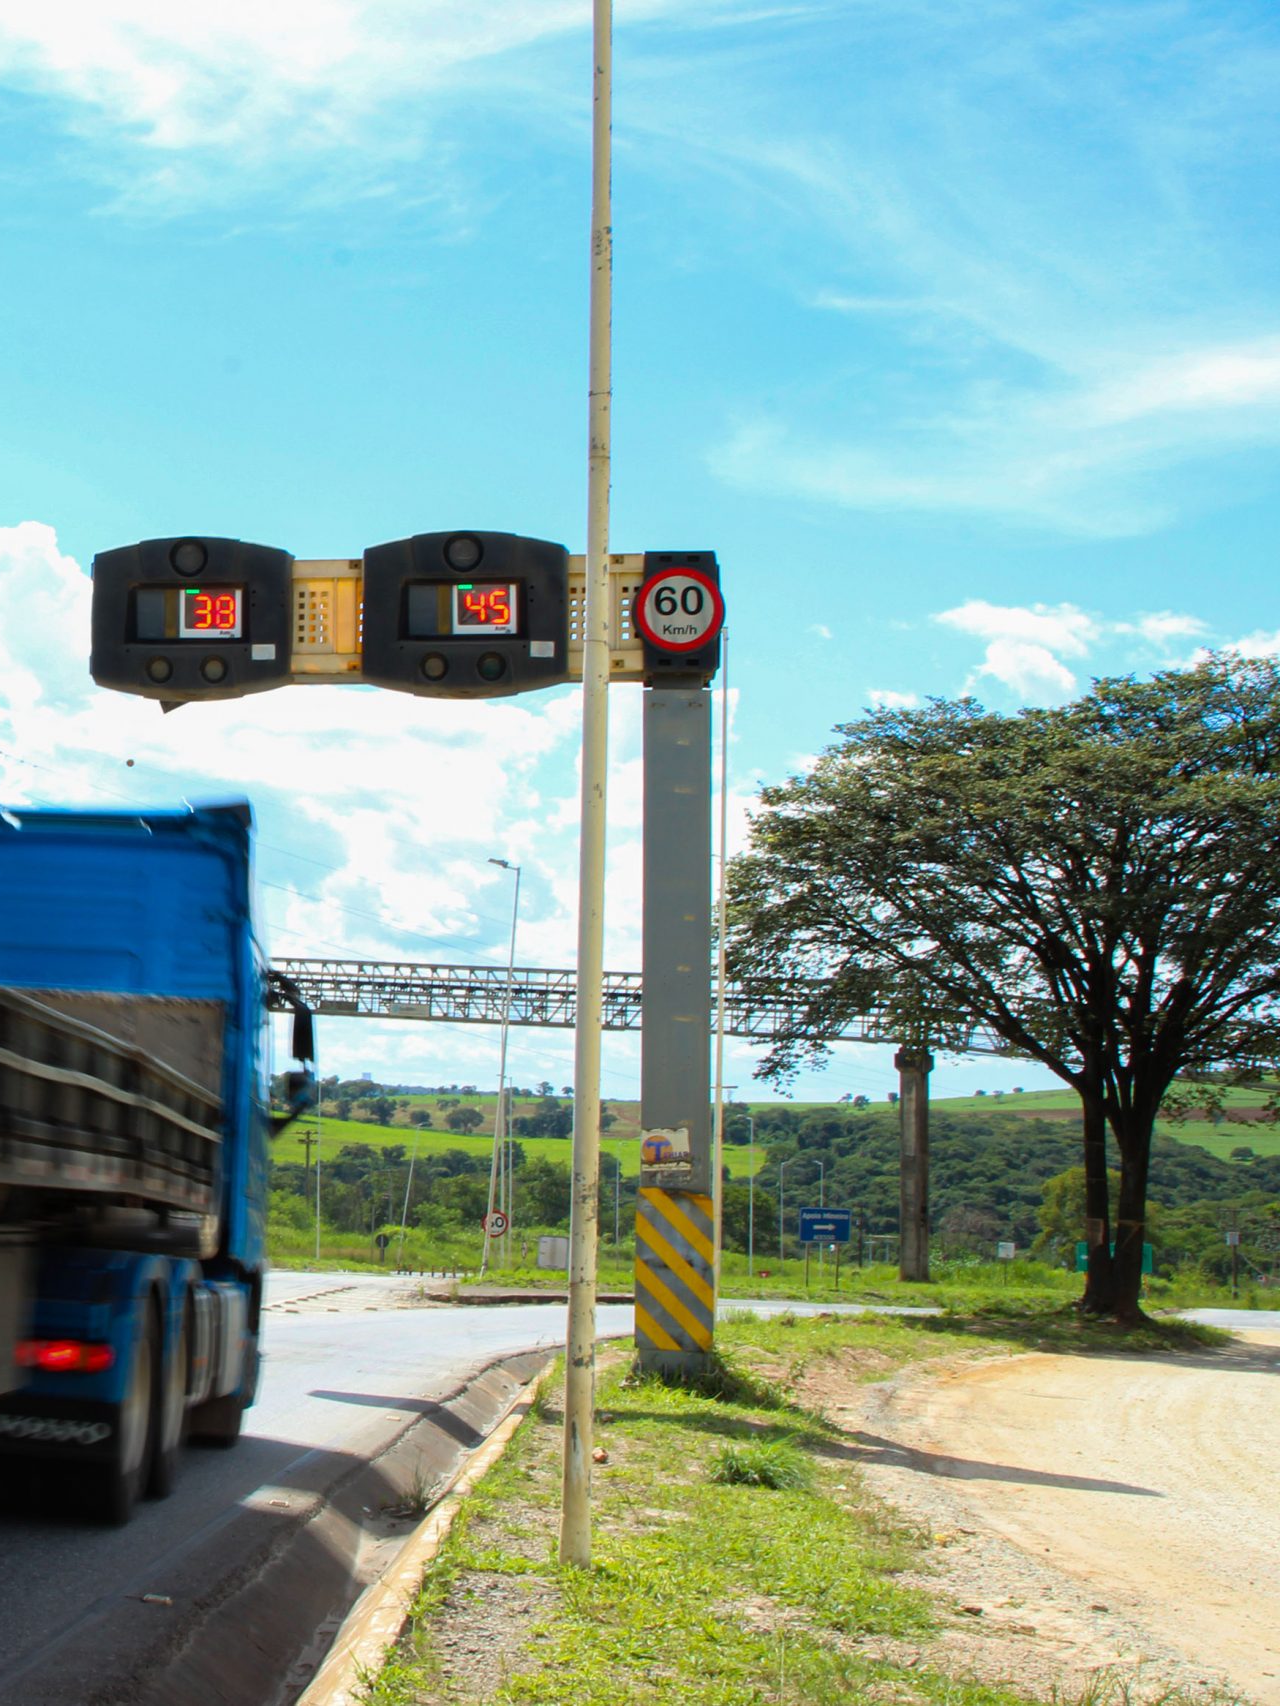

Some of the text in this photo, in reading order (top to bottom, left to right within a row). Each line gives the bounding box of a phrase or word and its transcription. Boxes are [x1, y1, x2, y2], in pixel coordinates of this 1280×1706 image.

[194, 594, 235, 629] 38
[464, 589, 510, 624] 45
[654, 586, 704, 616] 60
[662, 624, 697, 635] Km/h
